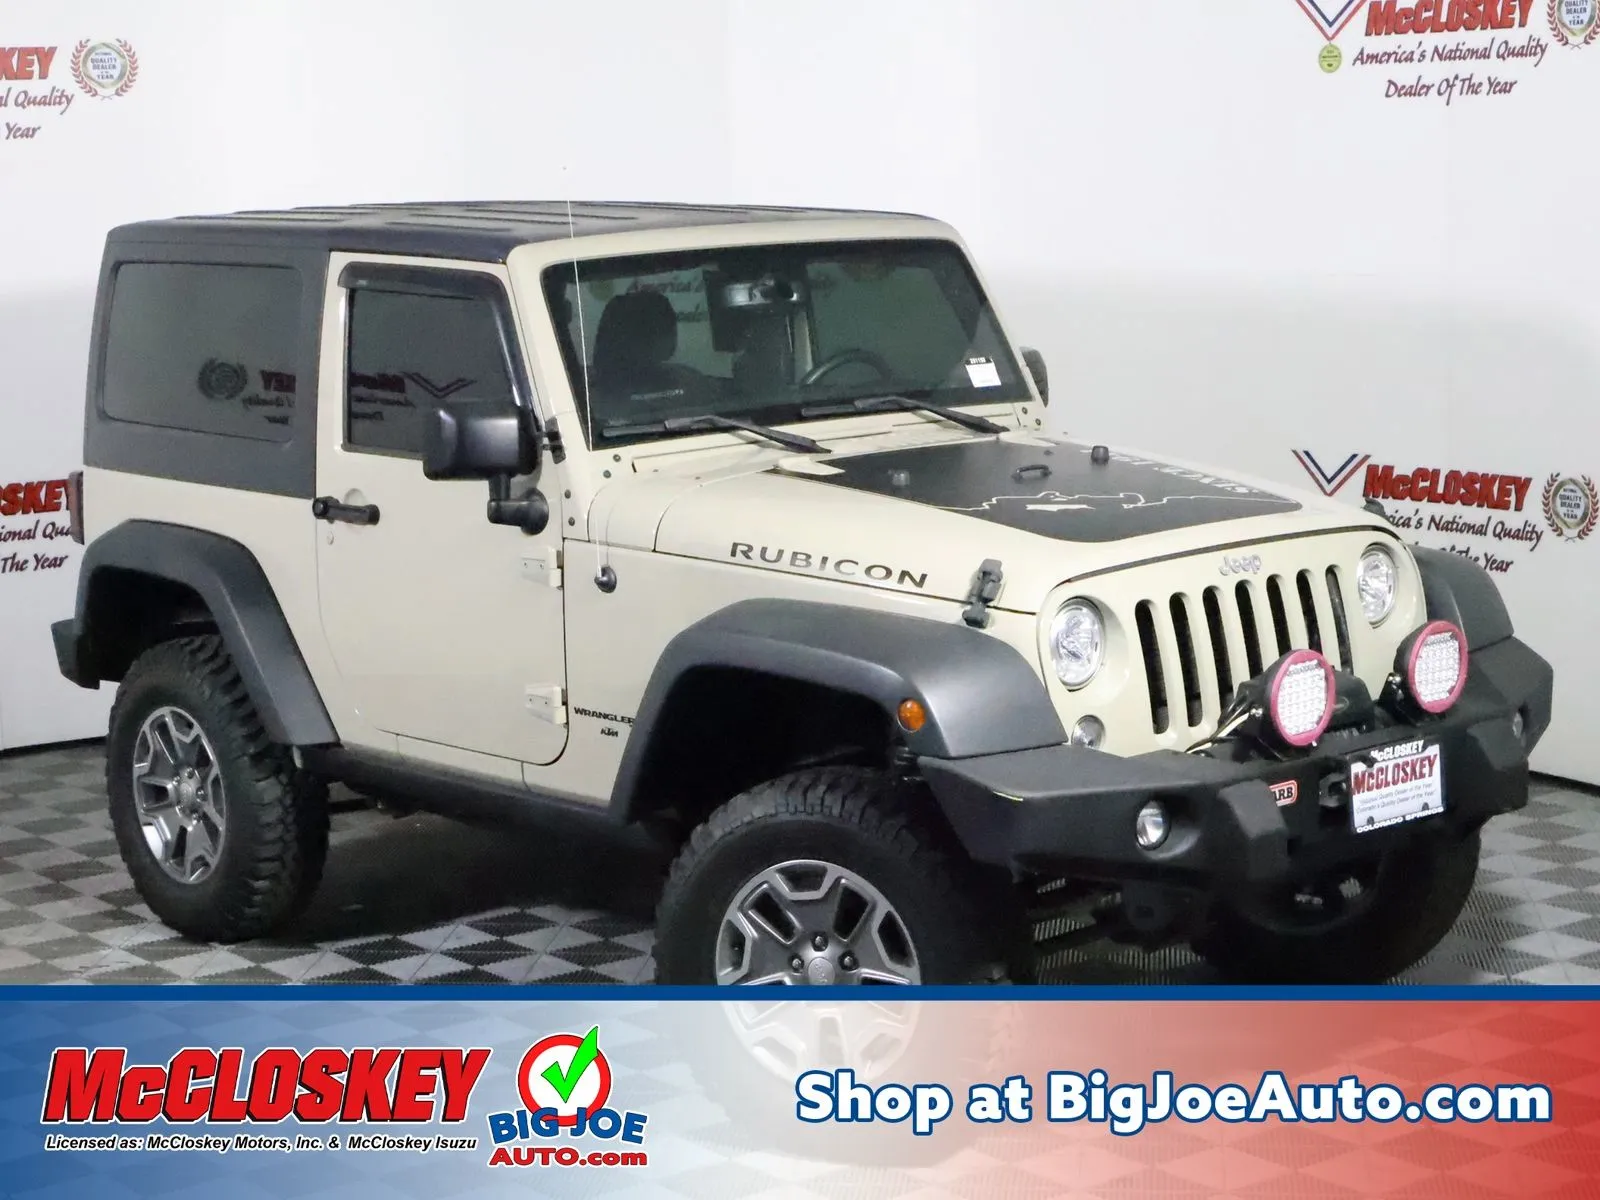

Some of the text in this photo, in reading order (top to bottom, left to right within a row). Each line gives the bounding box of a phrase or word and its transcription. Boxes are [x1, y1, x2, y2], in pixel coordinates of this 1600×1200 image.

[1364, 0, 1533, 36] McCLOSKEY
[1352, 41, 1426, 66] America's
[1431, 37, 1495, 62] National
[1496, 35, 1548, 67] Quality
[14, 85, 75, 115] Quality
[1385, 73, 1517, 106] Dealer Of The Year
[5, 122, 42, 140] Year
[1363, 464, 1532, 512] McCLOSKEY
[1427, 514, 1492, 537] National
[1493, 520, 1543, 552] Quality
[1, 552, 68, 574] The Year
[730, 542, 928, 588] RUBICON
[1219, 554, 1262, 576] Jeep
[1484, 551, 1514, 573] Year
[574, 707, 635, 725] WRANGLER
[1370, 740, 1424, 761] McCLOSKEY
[1353, 754, 1438, 795] McCLOSKEY
[1357, 806, 1444, 833] COLORADO SPRINGS
